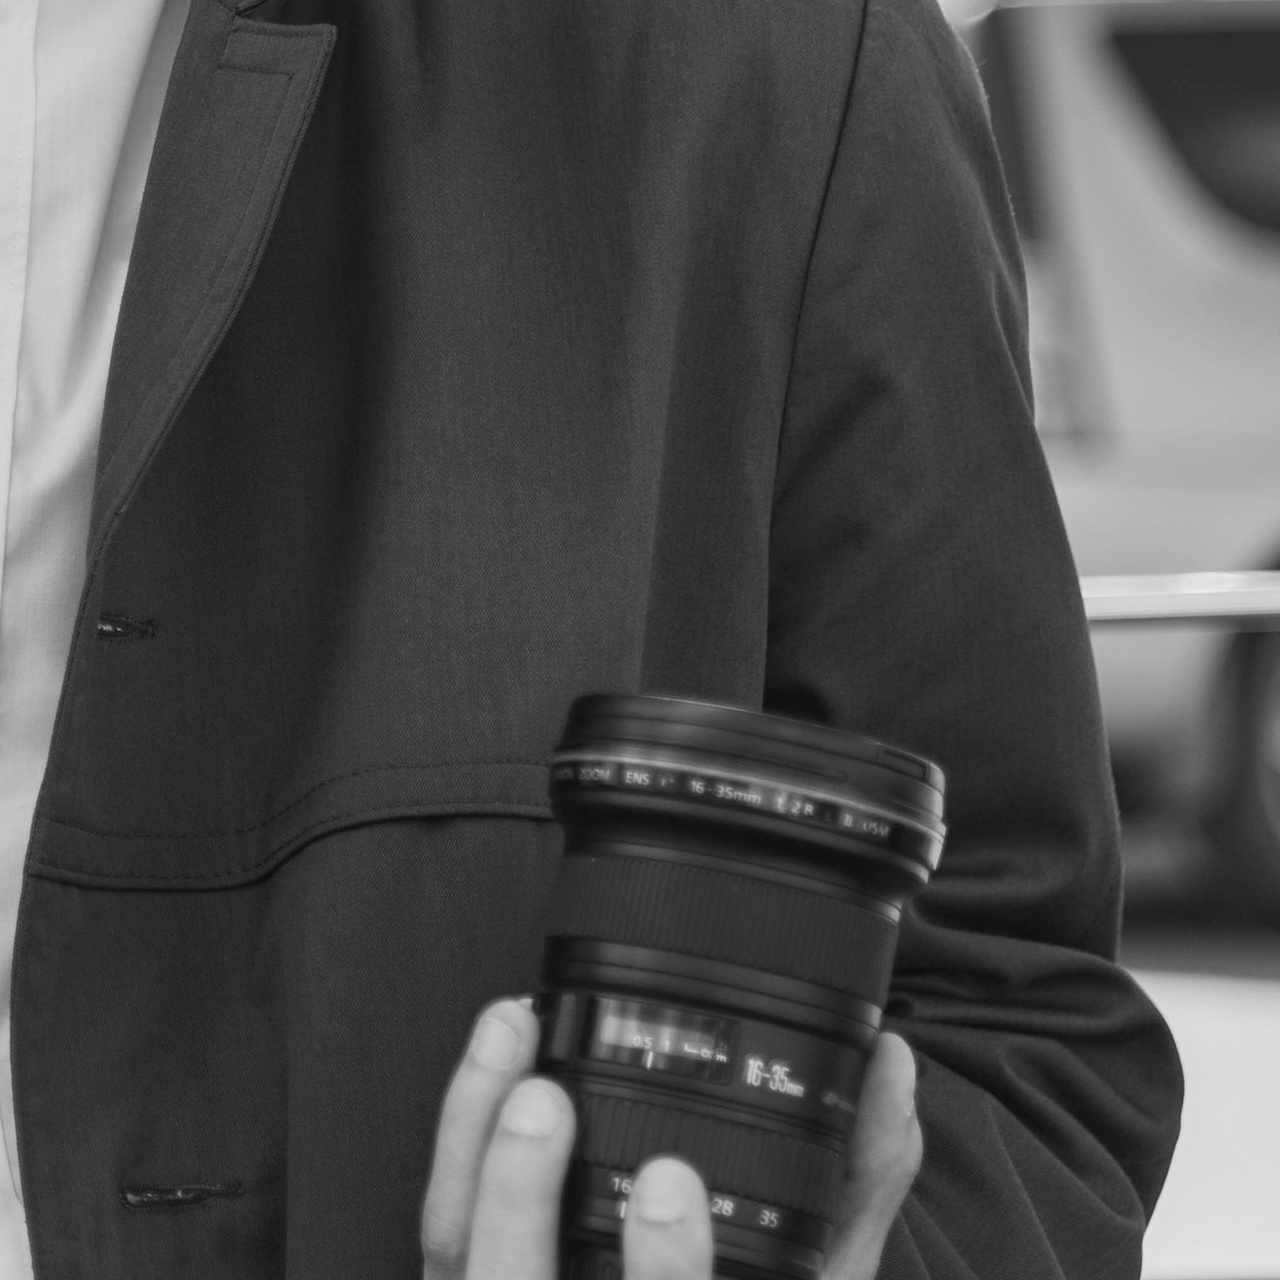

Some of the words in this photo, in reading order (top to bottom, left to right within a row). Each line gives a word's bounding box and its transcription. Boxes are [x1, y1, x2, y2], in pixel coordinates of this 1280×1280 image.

[746, 1058, 804, 1098] 16-35mm
[613, 1176, 632, 1195] 16
[711, 1198, 734, 1216] 28
[760, 1209, 780, 1228] 35
